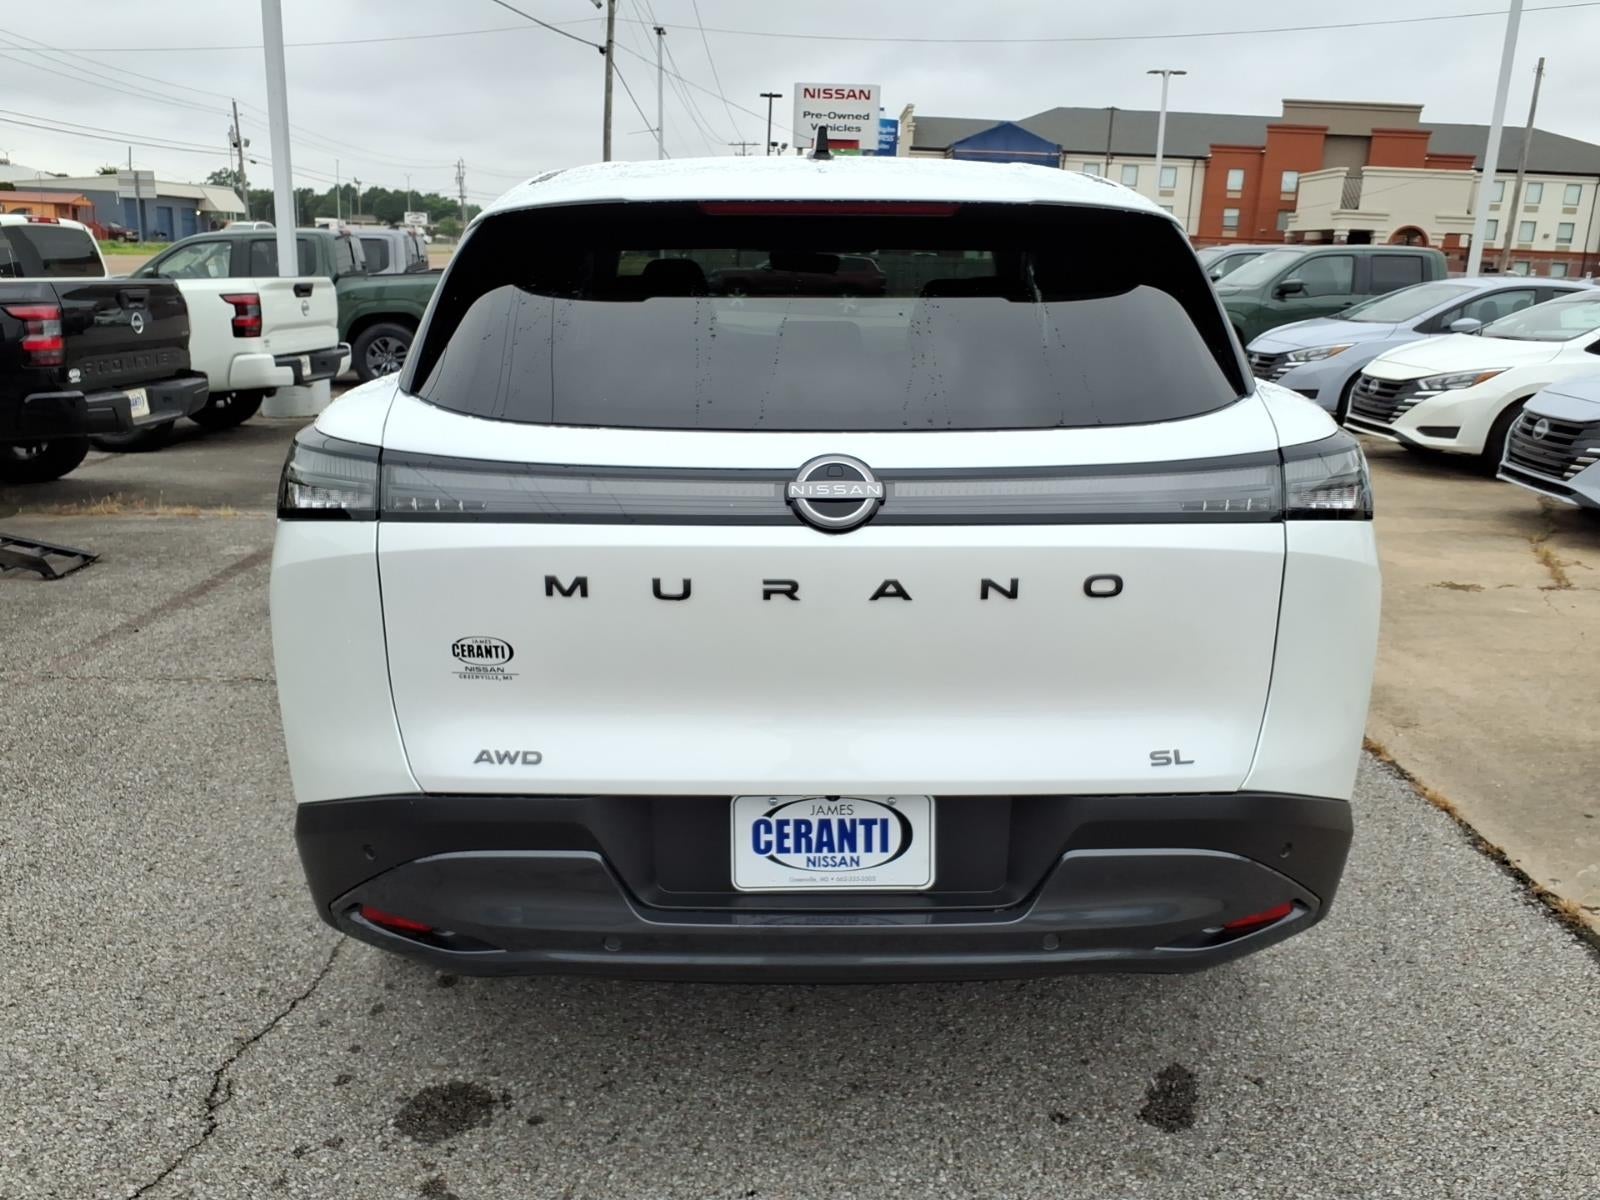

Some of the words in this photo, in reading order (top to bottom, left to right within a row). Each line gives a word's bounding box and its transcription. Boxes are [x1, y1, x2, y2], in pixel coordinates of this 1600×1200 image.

[803, 88, 871, 100] NISSAN
[802, 111, 870, 121] Pre-Owned
[810, 123, 862, 133] Vhicles
[791, 485, 881, 495] NISSAN
[544, 573, 1124, 601] MURANO
[452, 643, 505, 659] CERANTI
[473, 749, 542, 765] AWD
[1149, 749, 1195, 766] SL
[810, 804, 854, 816] JAMES
[752, 818, 889, 855] CERANTI
[806, 855, 860, 868] NISSAN
